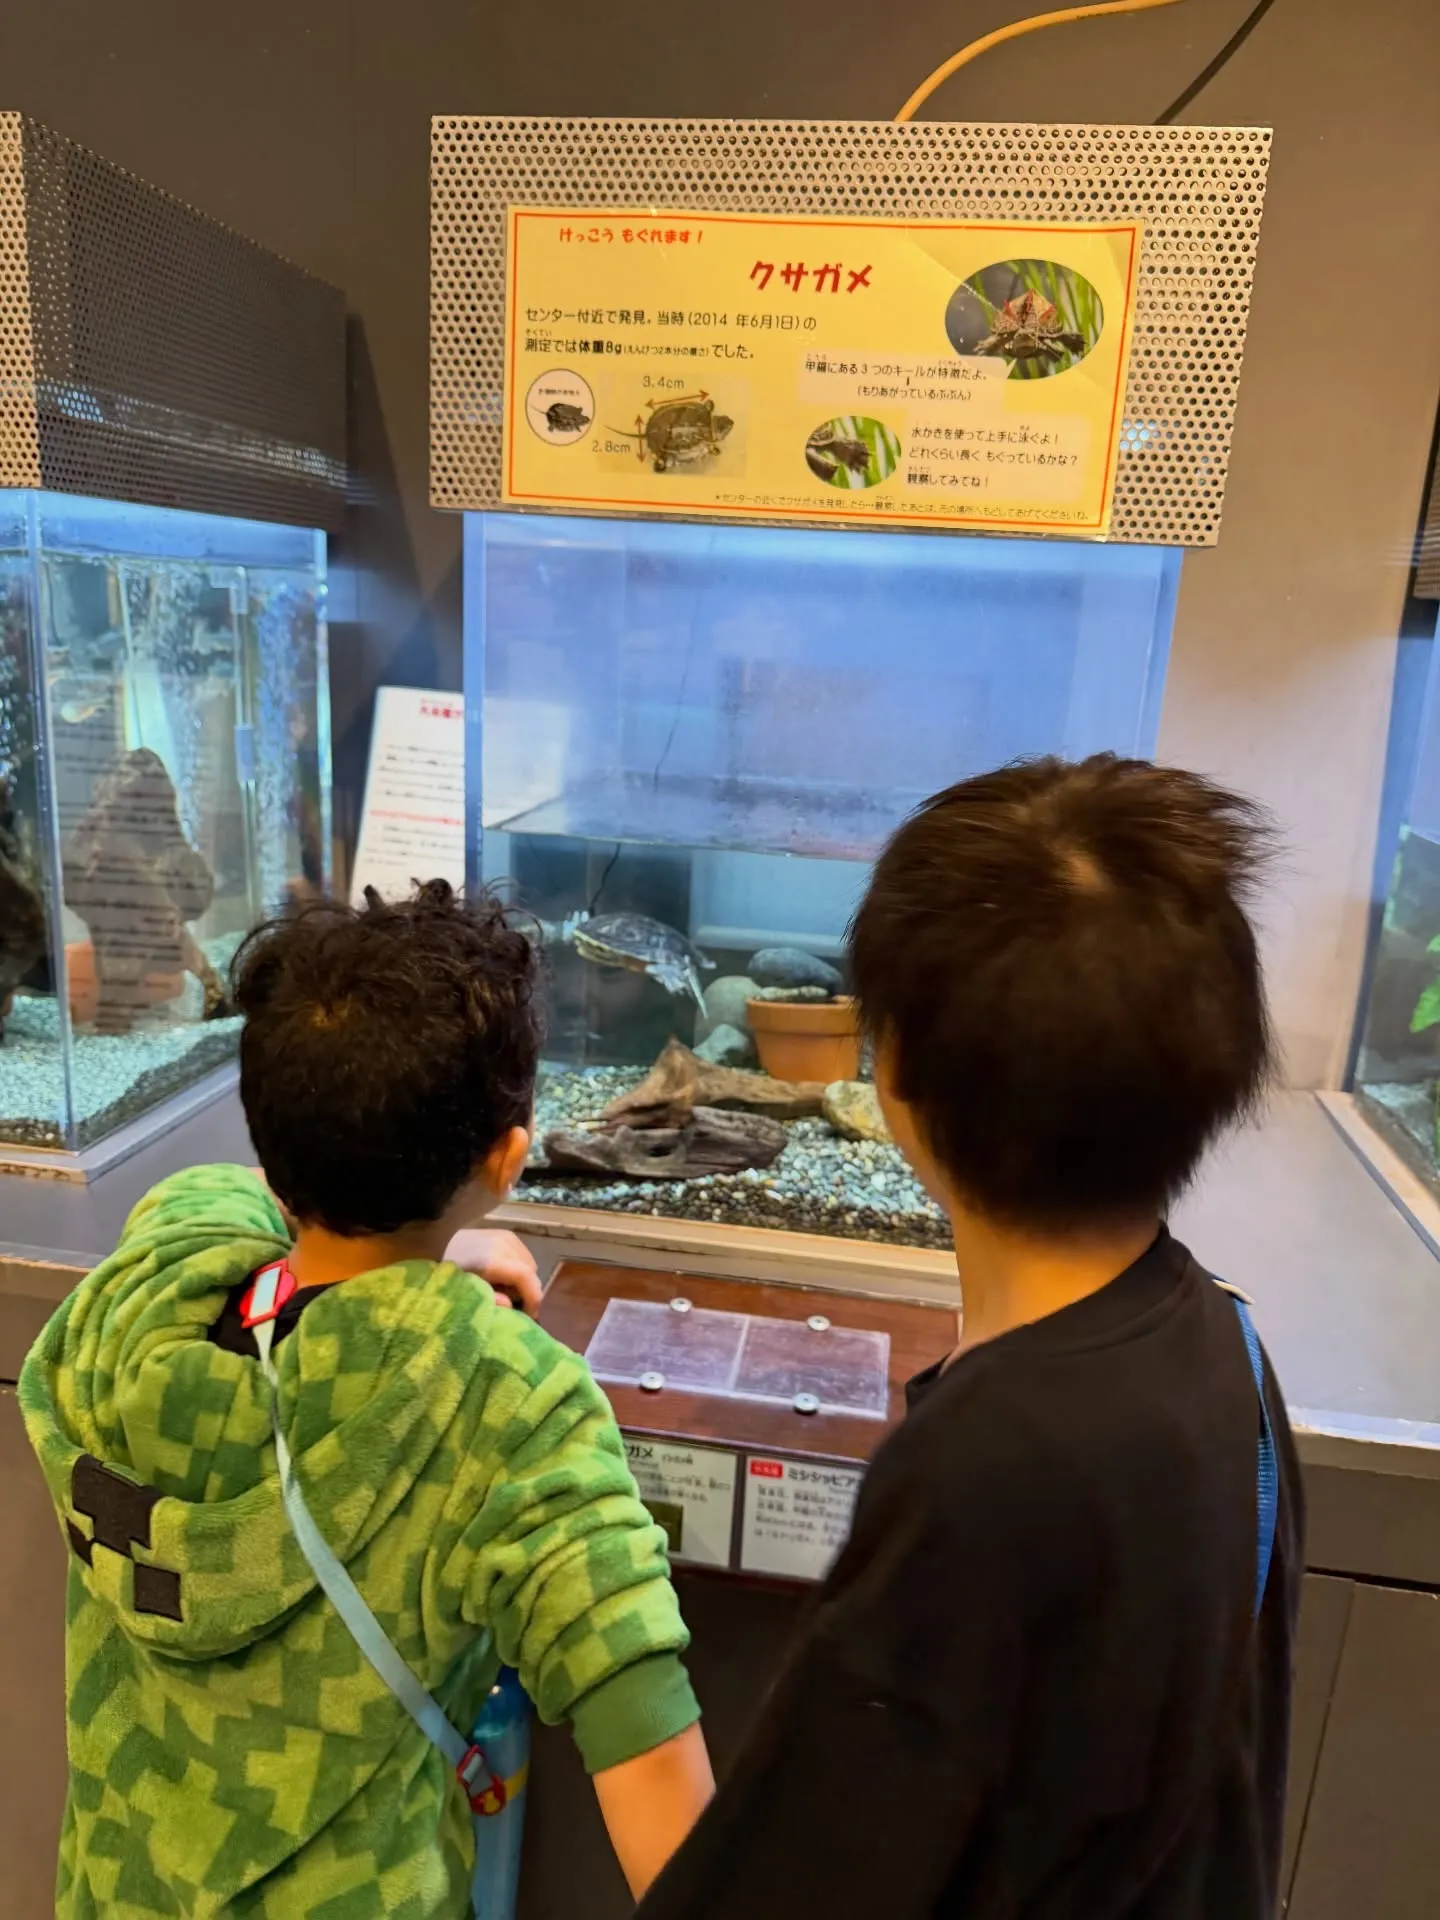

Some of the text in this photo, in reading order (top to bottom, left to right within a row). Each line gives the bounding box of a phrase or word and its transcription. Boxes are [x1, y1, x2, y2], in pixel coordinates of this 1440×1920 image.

[559, 227, 704, 244] けっこう もぐれます！
[749, 260, 873, 293] クサガメ
[642, 375, 685, 389] 3.4cm
[592, 440, 631, 453] 2.8cm
